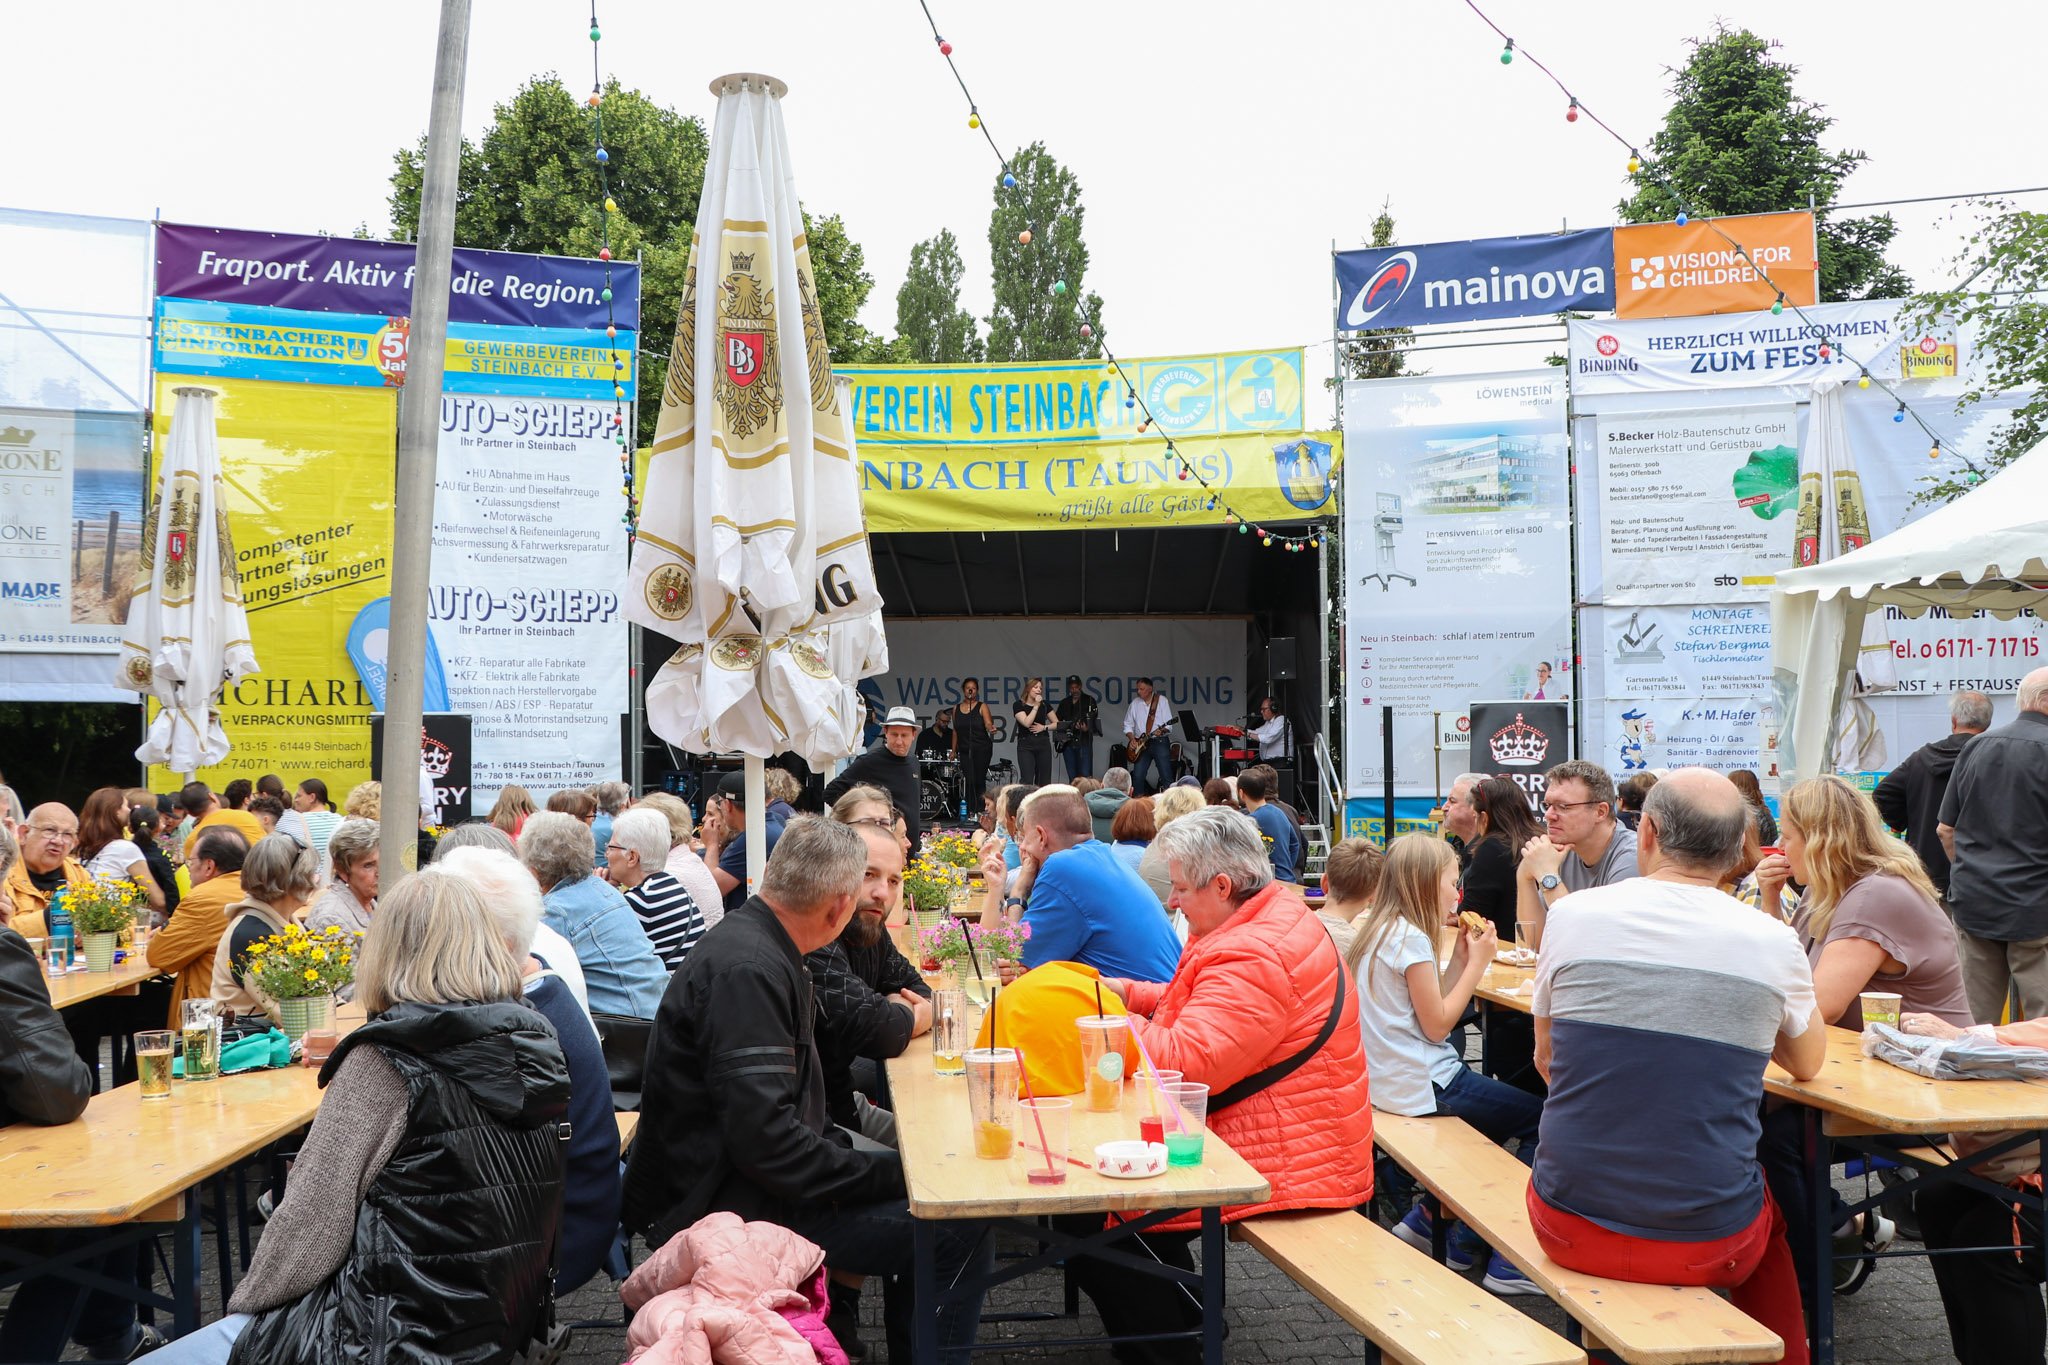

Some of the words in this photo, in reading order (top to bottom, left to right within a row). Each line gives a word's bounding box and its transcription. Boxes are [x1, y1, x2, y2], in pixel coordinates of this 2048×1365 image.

[1669, 250, 1735, 270] VISION
[1753, 247, 1791, 263] FOR
[198, 251, 314, 285] Fraport.
[323, 260, 397, 288] Aktiv
[452, 271, 494, 296] die
[503, 275, 601, 308] Region.
[1669, 266, 1767, 287] CHILDREN
[1424, 266, 1606, 309] mainova
[725, 319, 767, 329] NDING
[180, 323, 346, 347] STEINBACHER
[1648, 332, 1744, 350] HERZLICH
[1749, 320, 1888, 345] WILLKOMMEN
[180, 337, 346, 360] INFORMATION
[464, 341, 607, 362] GEWERBEVEREIN
[1579, 357, 1638, 373] BINDING
[1690, 349, 1755, 373] ZUM
[1905, 354, 1953, 367] BINDING
[471, 359, 564, 377] STEINBACH
[571, 366, 600, 378] E.V.
[1477, 385, 1552, 400] LÖWENSTEIN
[969, 379, 1135, 434] STEINBACH
[1520, 398, 1552, 406] medical
[439, 397, 620, 440] UTO-SCHEPP
[1608, 432, 1654, 442] S.Becker
[1657, 425, 1750, 440] Holz-Bautenschutz
[1755, 424, 1786, 433] GmbH
[460, 437, 474, 447] Ihr
[477, 438, 513, 448] Partner
[516, 439, 525, 449] in
[528, 440, 576, 452] Steinbach
[1609, 443, 1682, 455] Malerwerkstatt
[1687, 441, 1706, 451] und
[1710, 439, 1762, 451] Gerüstbau
[0, 450, 62, 472] ONE
[472, 470, 487, 479] HU
[489, 470, 532, 480] Abnahme
[535, 471, 544, 481] im
[547, 472, 570, 482] Haus
[860, 460, 1029, 491] NBACH
[1044, 448, 1233, 496] (TAUNUS)
[458, 481, 470, 491] für
[473, 483, 506, 493] Benzin-
[510, 484, 525, 494] und
[529, 485, 599, 498] Dieselfahrzeuge
[481, 497, 560, 509] Zulassungsdienst
[1060, 494, 1113, 522] grüßt
[1120, 493, 1154, 514] alle
[1161, 491, 1222, 518] Gäst!
[489, 511, 553, 523] Motorwäsche
[1643, 515, 1684, 524] Bautenschutz
[440, 523, 508, 535] Reifenwechsel
[510, 525, 518, 535] &
[520, 526, 600, 538] Reifeneinlagerung
[1426, 528, 1503, 539] Intensivventilator
[1505, 526, 1525, 535] elisa
[1527, 525, 1543, 533] 800
[1685, 524, 1721, 532] Ausführung
[236, 523, 354, 562] ompetenter
[1648, 535, 1699, 543] Tapezierarbeiten
[1705, 532, 1768, 541] Fassadengestaltung
[511, 539, 519, 549] &
[521, 540, 609, 552] Fahrwerksreparatur
[1611, 545, 1664, 554] Wärmedämmung
[1669, 544, 1694, 552] Verputz
[1731, 542, 1764, 550] Gerüstbau
[474, 553, 567, 566] Kundenersatzwagen
[239, 559, 294, 584] artner
[300, 549, 329, 566] für
[2, 582, 61, 598] MARE
[1692, 608, 1753, 620] MONTAGE
[459, 625, 472, 635] Ihr
[475, 626, 511, 636] Partner
[514, 626, 523, 636] in
[527, 626, 575, 637] Steinbach
[19, 635, 54, 643] 61449
[58, 635, 122, 644] STEINBACH
[1360, 635, 1378, 643] Neu
[1381, 634, 1389, 642] in
[1391, 633, 1437, 642] Steinbach:
[1674, 641, 1716, 653] Stefan
[1719, 640, 1771, 653] Bergma
[454, 657, 472, 666] KFZ
[480, 658, 524, 669] Reparatur
[527, 658, 542, 668] alle
[545, 658, 585, 669] Fabrikate
[1693, 654, 1764, 664] Tischlermeister
[460, 671, 477, 680] KFZ
[485, 671, 519, 681] Elektrik
[521, 671, 537, 681] alle
[539, 671, 580, 682] Fabrikate
[492, 686, 516, 696] nach
[518, 686, 597, 697] Herstellervorgabe
[1950, 679, 2022, 691] FESTAUSS
[495, 701, 516, 710] ABS
[523, 701, 541, 710] ESP
[550, 701, 593, 712] Reparatur
[232, 715, 372, 726] VERPACKUNGSMITTE
[514, 715, 608, 726] Motorinstandsetzung
[474, 728, 568, 740] Unfallinstandsetzung
[1444, 733, 1470, 743] BINDI
[1667, 735, 1702, 744] Heizung
[1710, 734, 1720, 742] Öl
[1729, 735, 1744, 743] Gas
[280, 742, 310, 751] 61449
[314, 741, 362, 751] Steinbach
[1667, 748, 1698, 756] Sanitär
[1706, 748, 1759, 756] Badrenovier
[503, 761, 527, 769] 61449
